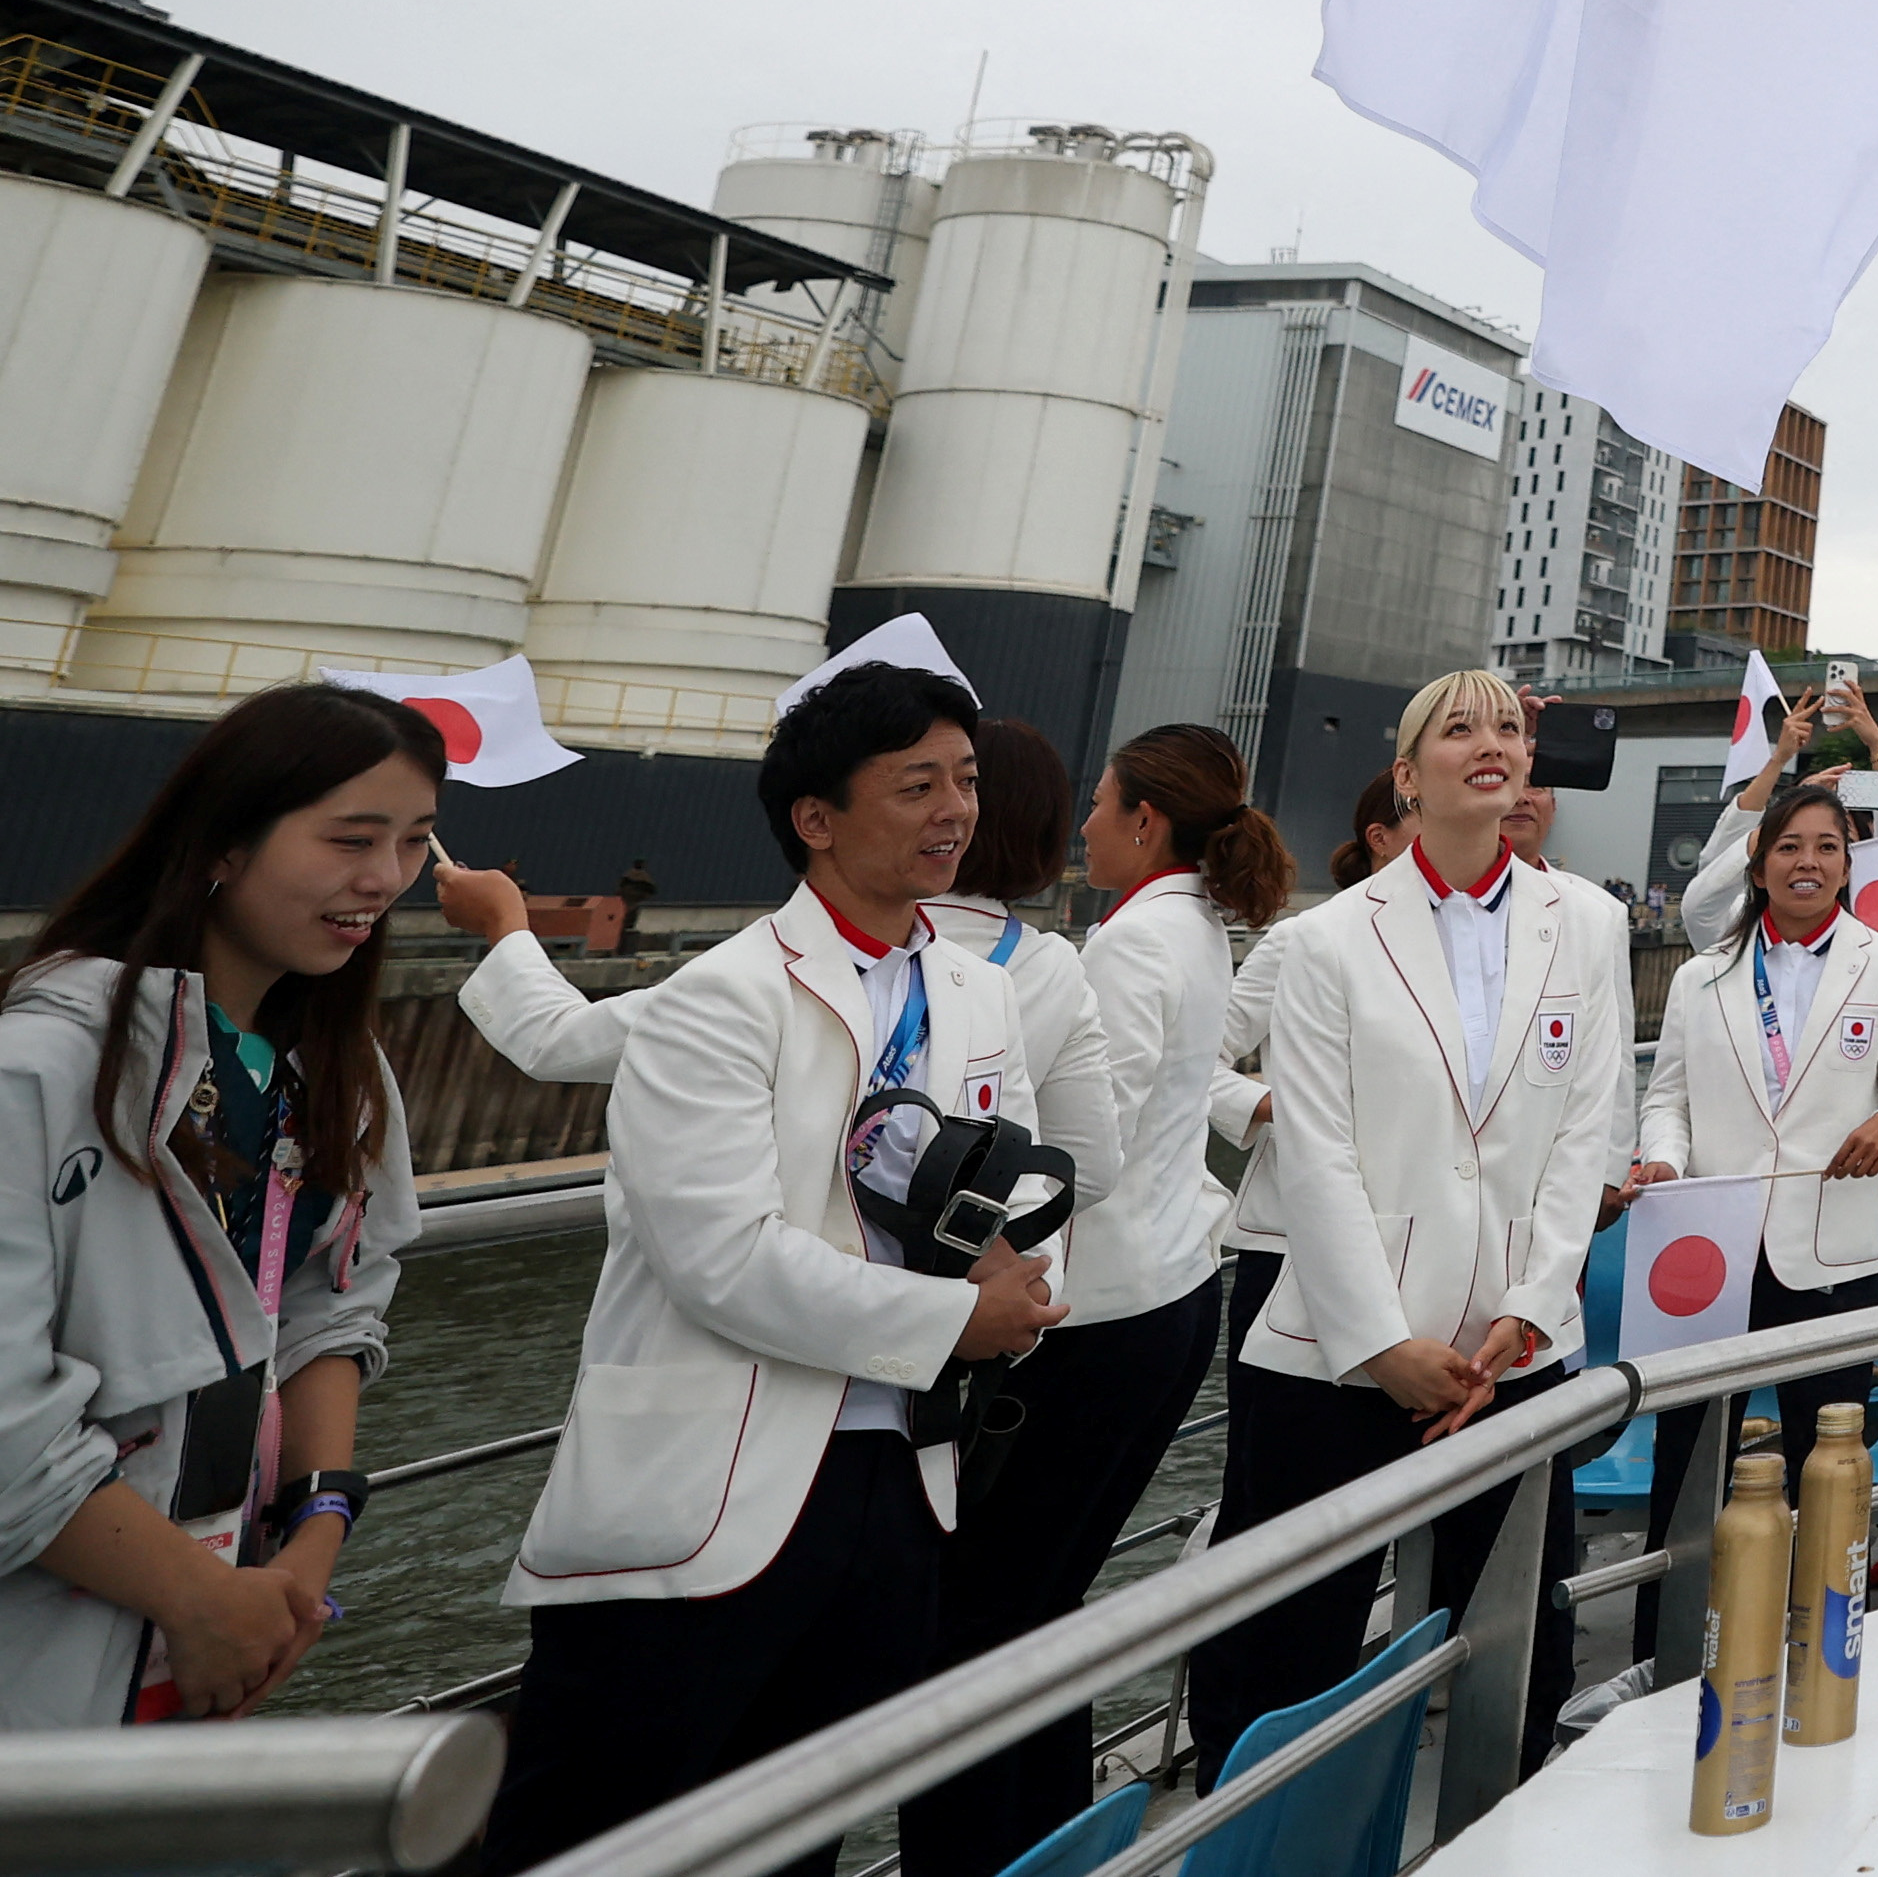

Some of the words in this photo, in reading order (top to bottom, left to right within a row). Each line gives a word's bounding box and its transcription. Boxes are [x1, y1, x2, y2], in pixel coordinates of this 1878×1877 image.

[1432, 382, 1497, 432] CEMEX
[882, 1044, 898, 1071] Atos
[262, 1247, 279, 1307] PARIS
[1844, 1536, 1869, 1661] smart
[1707, 1609, 1722, 1670] water
